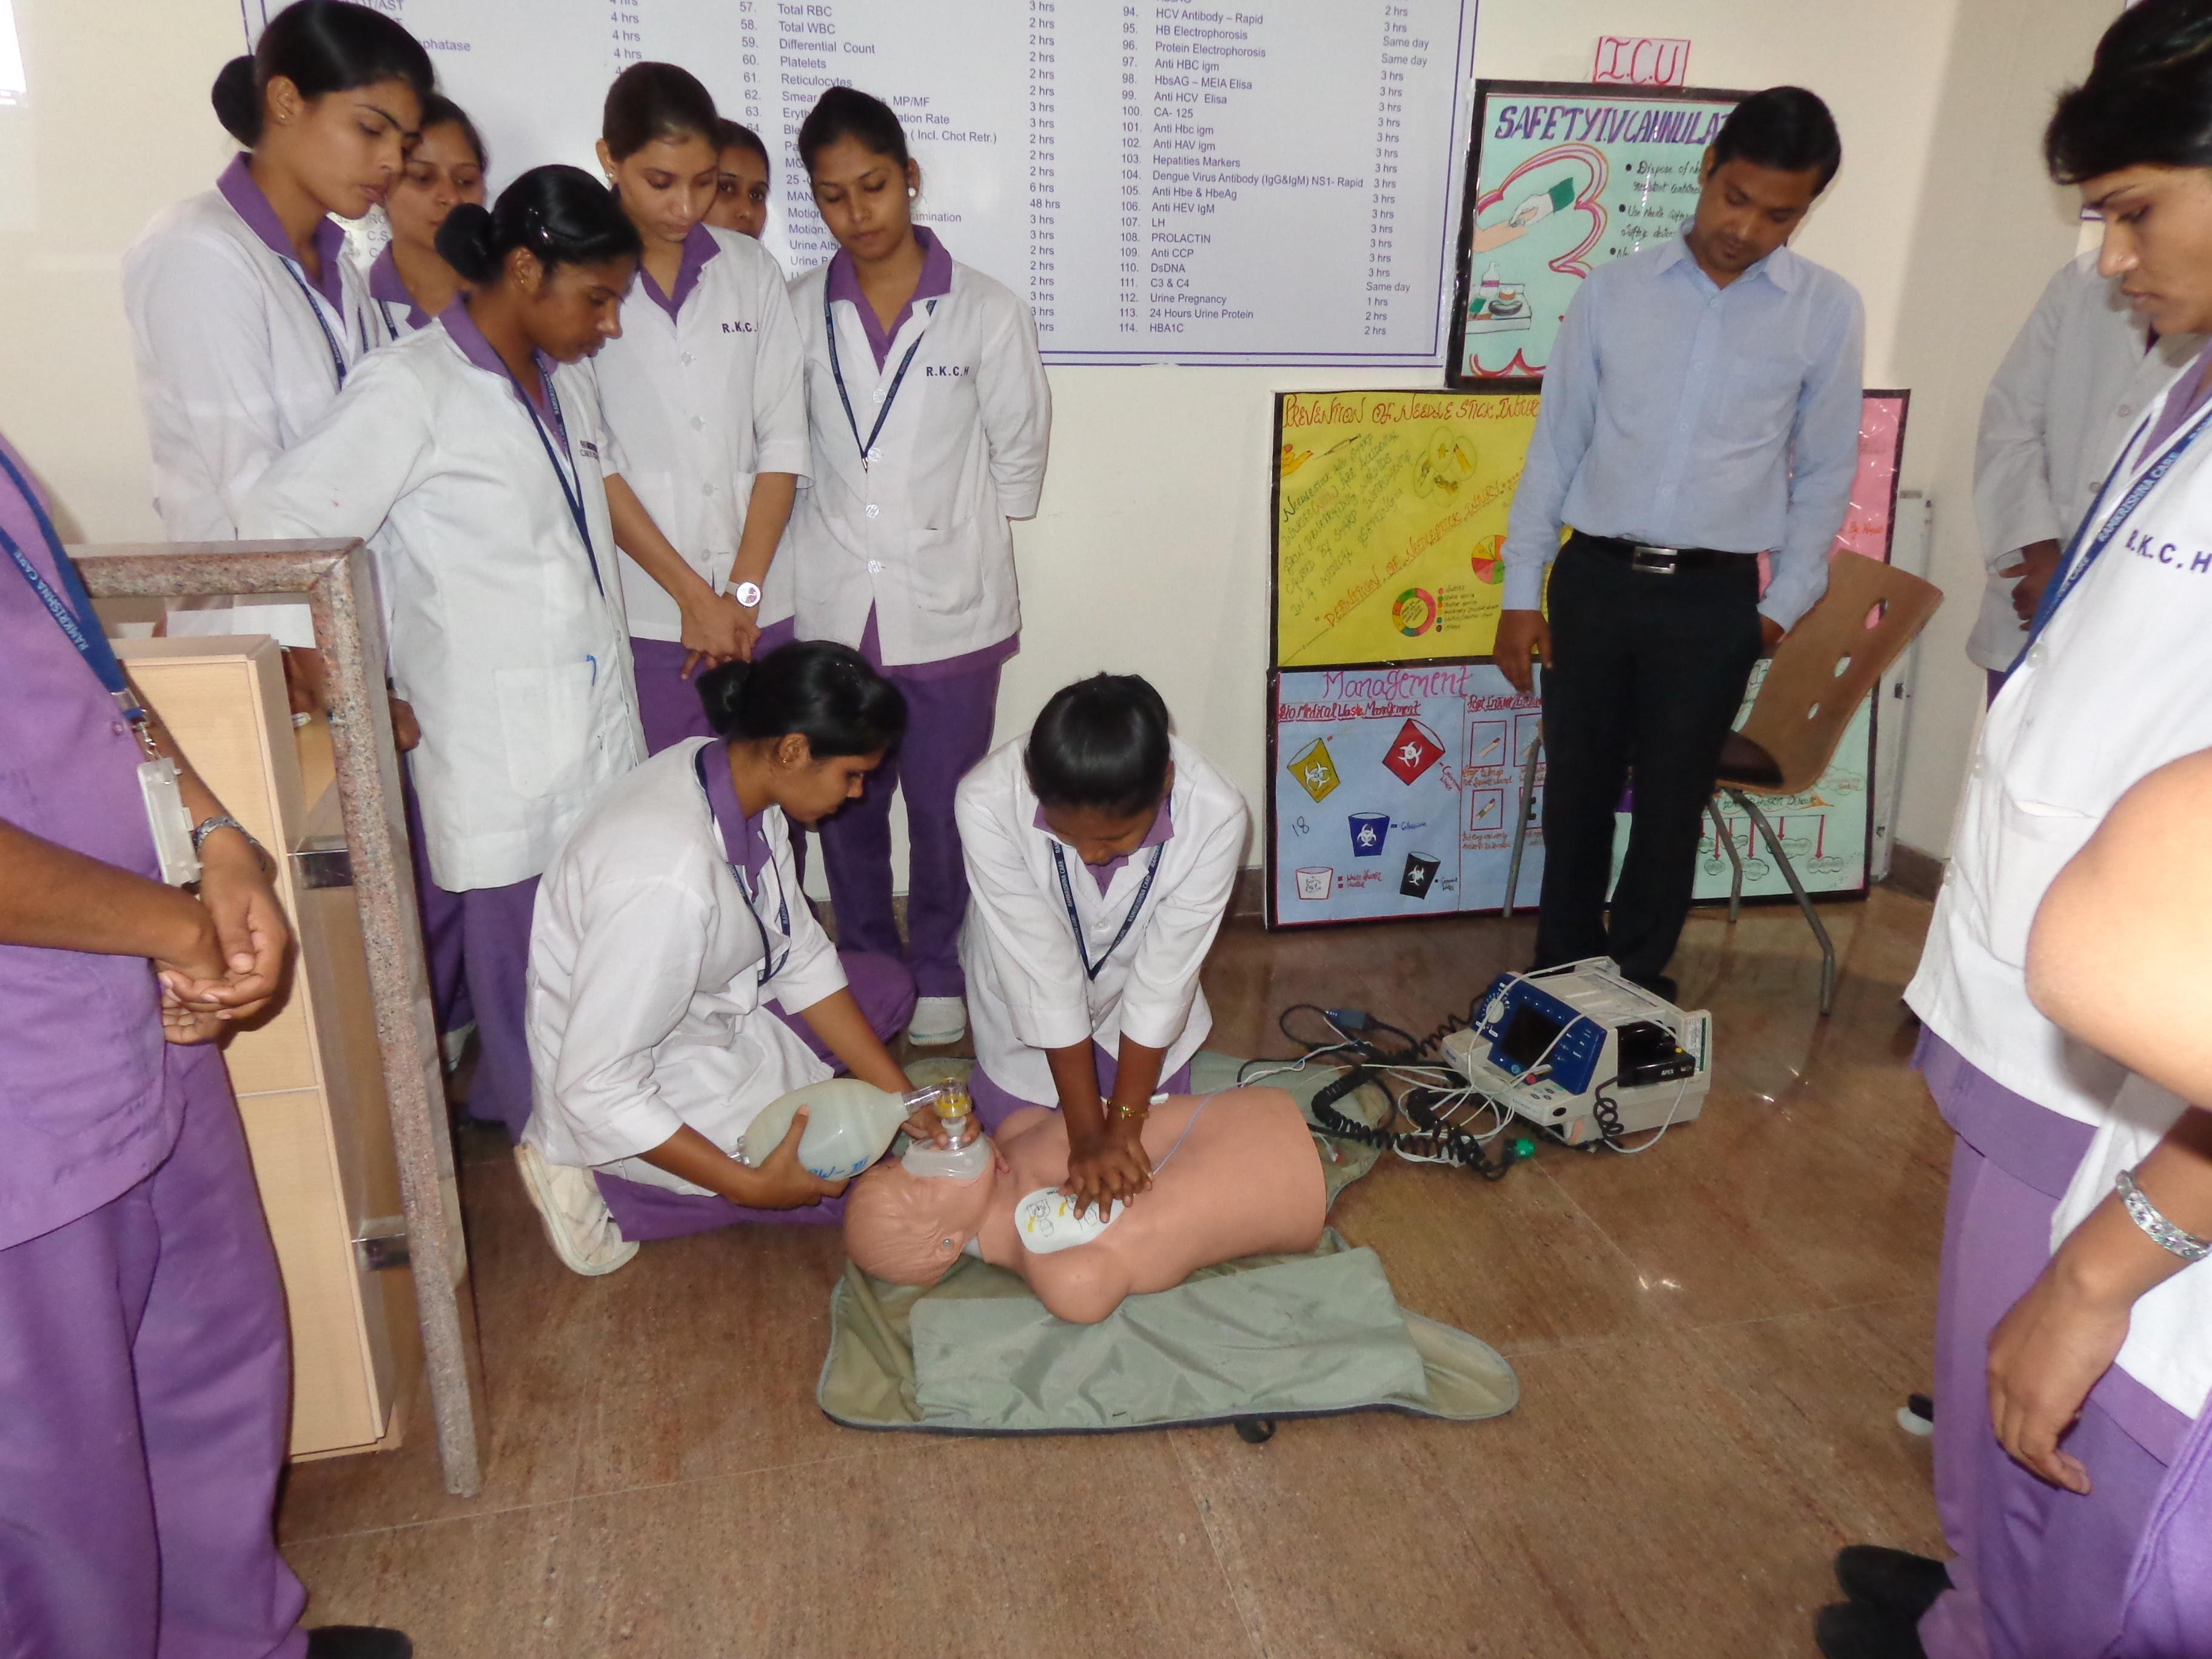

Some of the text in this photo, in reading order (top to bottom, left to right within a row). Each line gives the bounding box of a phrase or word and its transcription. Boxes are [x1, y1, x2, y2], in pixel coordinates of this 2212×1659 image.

[740, 1, 832, 17] 57. Total RBC
[1385, 5, 1408, 17] 2 hrs
[611, 12, 639, 24] 4 hrs
[1029, 17, 1054, 28] 2 hrs
[1123, 7, 1263, 26] 94. HCV Antibody Rapid
[741, 19, 835, 35] 58. Total WBC
[1122, 22, 1138, 33] 95.
[1156, 25, 1170, 35] HB
[742, 36, 875, 54] 59. Differential Count
[1122, 39, 1138, 50] 96.
[1155, 41, 1190, 53] Protein
[1383, 35, 1429, 51] Same day
[614, 48, 642, 59] 4 hrs
[742, 54, 826, 69] 60. Platelets
[1122, 56, 1137, 67] 97.
[1155, 58, 1174, 69] Anti
[744, 73, 760, 83] 61.
[1122, 73, 1252, 90] 98. HbsAG MEIA Elisa
[744, 89, 930, 107] 62. Smear MP/MF
[1122, 90, 1227, 104] 99. Anti HCV Elisa
[1030, 101, 1054, 112] 3 hrs
[1123, 106, 1142, 116] 100.
[1176, 108, 1193, 119] 125
[1379, 101, 1401, 112] 3 hrs
[745, 106, 762, 117] 63.
[925, 113, 950, 124] Rate
[746, 123, 762, 133] 64.
[1122, 122, 1141, 132] 101.
[1153, 122, 1172, 133] Anti
[1495, 105, 1601, 142] SAFETY
[1623, 109, 1731, 145] CANNULA
[1122, 138, 1141, 148] 102.
[1153, 139, 1171, 149] Anti
[1175, 139, 1196, 150] HAV
[1122, 153, 1141, 164] 103.
[1203, 156, 1241, 167] Markers
[1122, 169, 1141, 179] 104.
[1153, 170, 1190, 183] Dengue
[1192, 172, 1216, 183] Virus
[1218, 173, 1259, 186] Antibody
[1337, 176, 1363, 189] Rapid
[1030, 182, 1054, 193] 6 hrs
[1122, 185, 1141, 195] 105.
[1151, 186, 1170, 196] Anti
[1173, 187, 1193, 197] Hbe
[1196, 187, 1202, 197] &
[1030, 198, 1061, 209] 48 hrs
[1122, 201, 1141, 212] 106.
[1151, 202, 1170, 212] Anti
[1173, 203, 1195, 213] HEV
[1121, 217, 1165, 227] 107. LH
[1121, 232, 1211, 243] 108. PROLACTIN
[789, 240, 817, 250] Urine
[1121, 247, 1194, 258] 109. Anti CCP
[790, 256, 818, 266] Urine
[1121, 263, 1139, 272] 110.
[1121, 278, 1189, 288] 111. C3 & C4
[1120, 293, 1227, 306] 112. Urine Pregnancy
[1367, 297, 1388, 306] 1 hrs
[1120, 308, 1253, 319] 113. 24 Hours Urine Protein
[1365, 311, 1387, 321] 2 hrs
[1120, 323, 1184, 333] 114. HBA1C
[1283, 394, 1364, 428] PREVENTION
[1395, 394, 1452, 423] NEEDLE
[1456, 400, 1492, 418] STICK
[1323, 665, 1472, 700] Management
